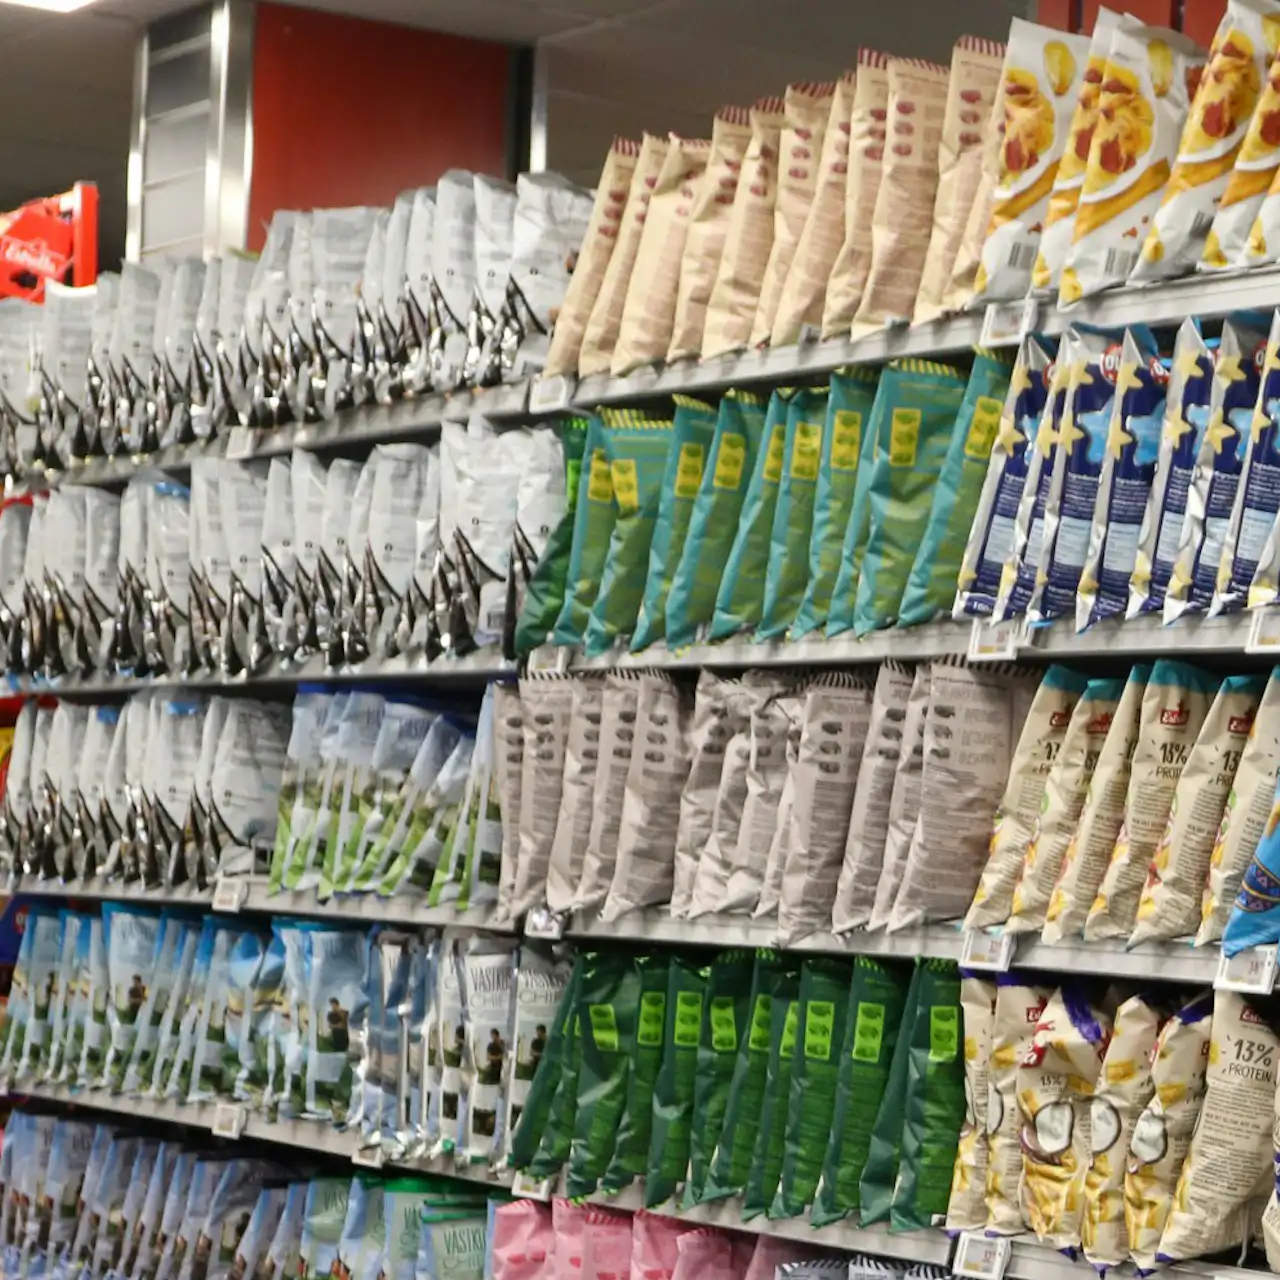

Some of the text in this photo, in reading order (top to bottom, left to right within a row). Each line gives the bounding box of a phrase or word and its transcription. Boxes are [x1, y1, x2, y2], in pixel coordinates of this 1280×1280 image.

[1160, 742, 1188, 764] 13%
[1222, 751, 1241, 773] 13
[1234, 1038, 1272, 1067] 13%
[1228, 1063, 1272, 1083] PROTEIN
